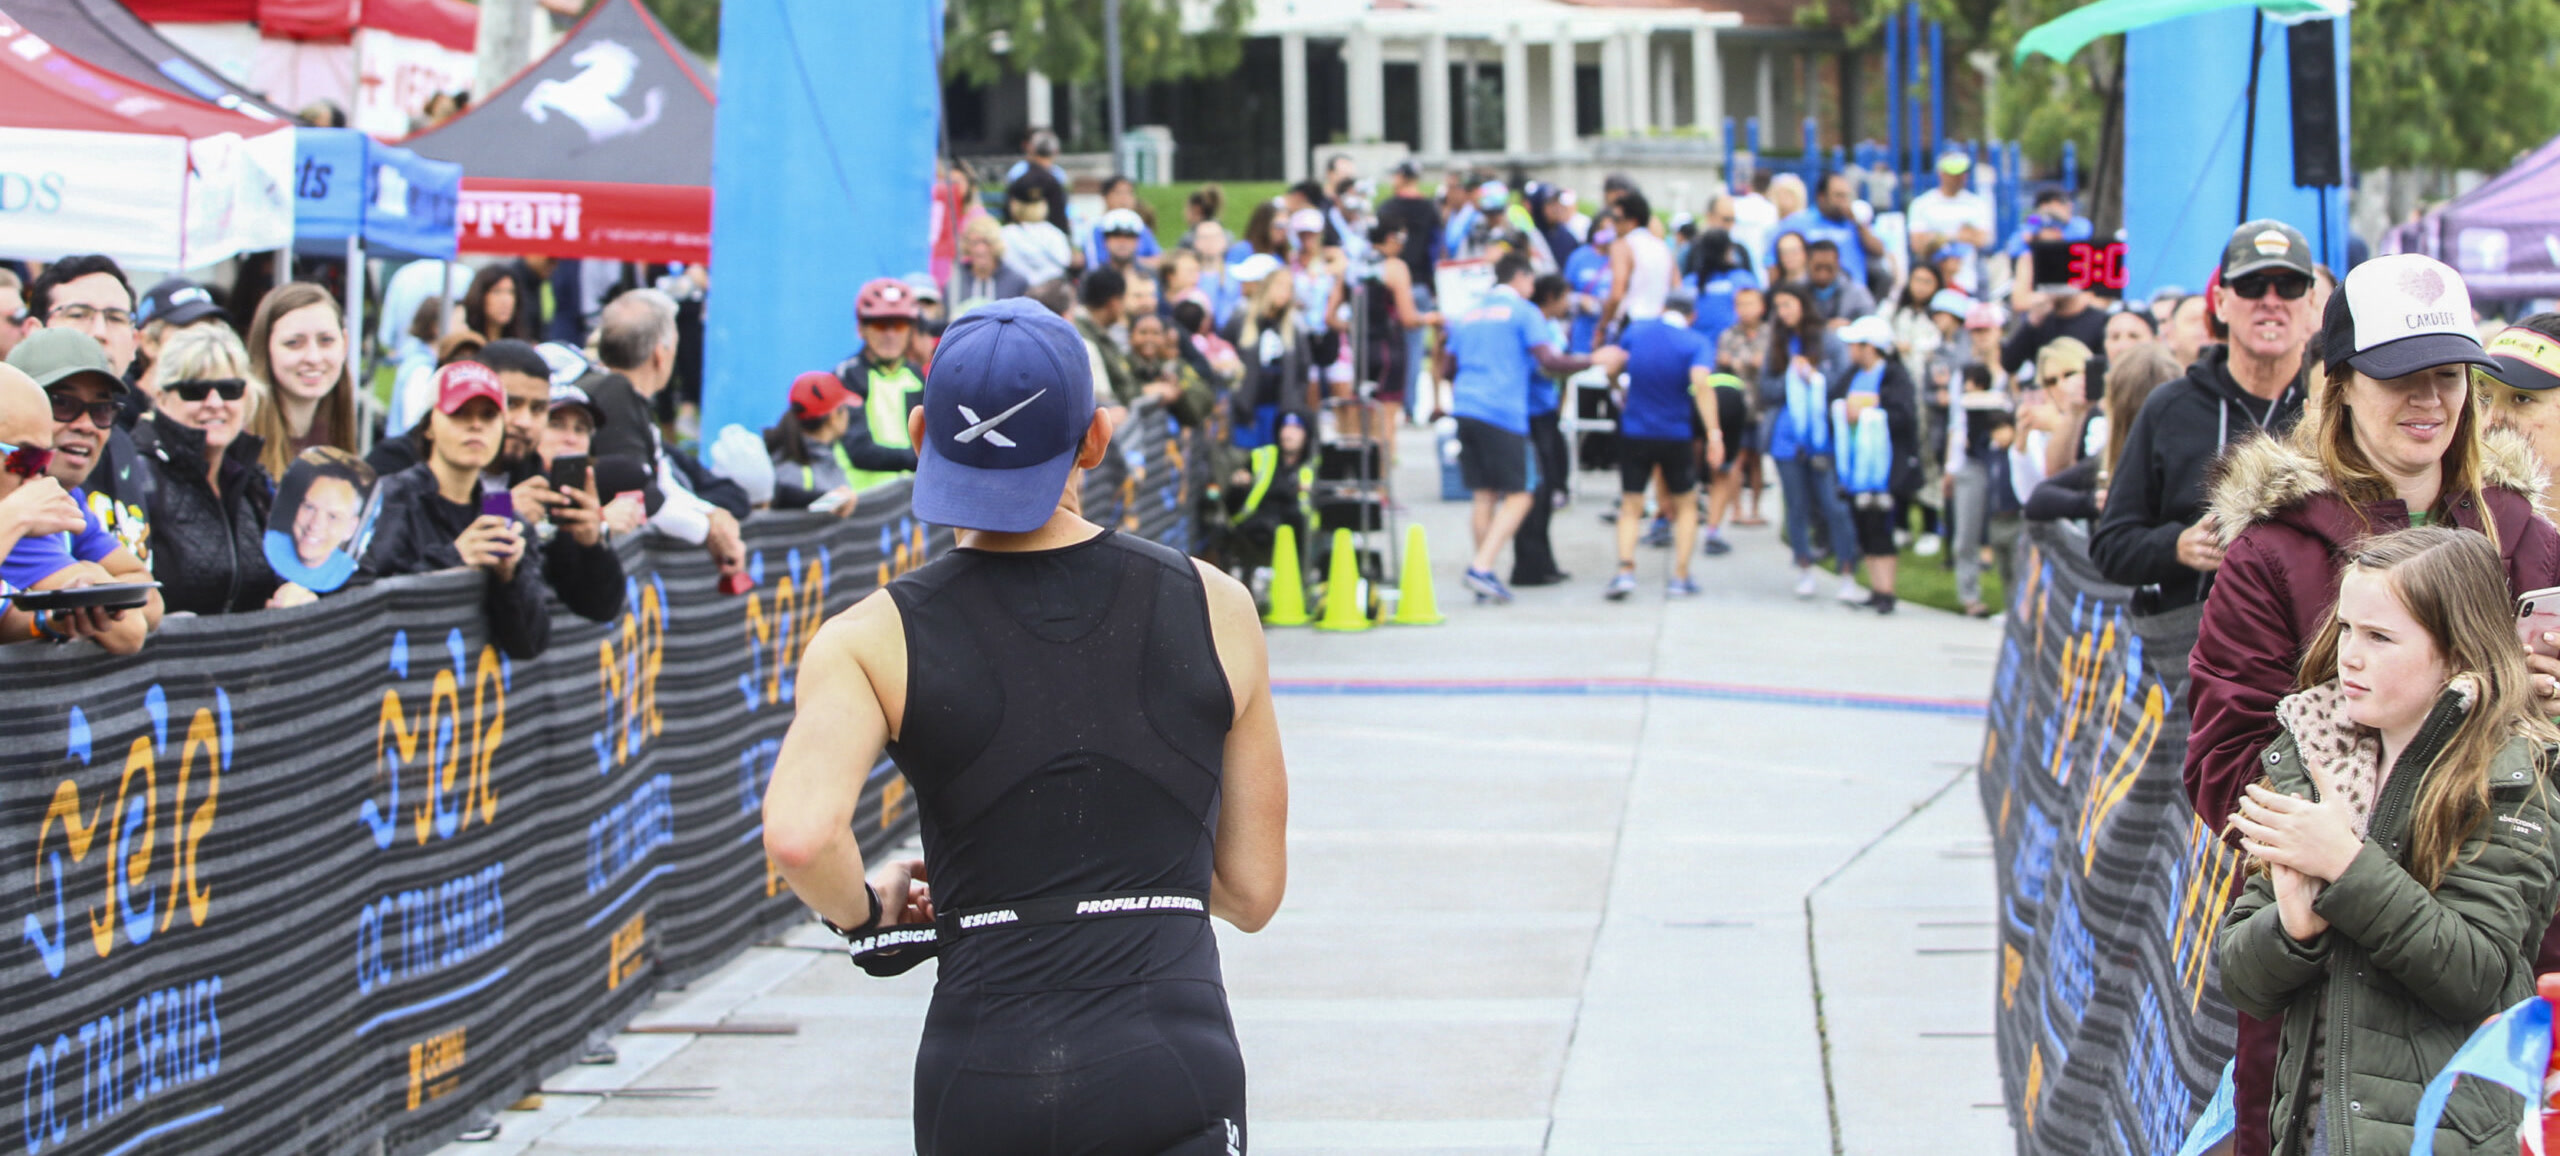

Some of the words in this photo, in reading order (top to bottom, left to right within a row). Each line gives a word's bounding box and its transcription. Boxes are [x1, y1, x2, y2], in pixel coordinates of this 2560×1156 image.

[296, 157, 332, 199] ts
[456, 191, 581, 241] rrari
[2406, 312, 2455, 329] CARDIFF
[1076, 897, 1149, 914] PROFILE
[1149, 896, 1202, 911] DESIGN
[357, 895, 393, 996] OC
[876, 928, 936, 948] DESIGN
[24, 1033, 70, 1155] OC
[79, 1007, 125, 1130] TRI
[134, 975, 222, 1102] SERIES
